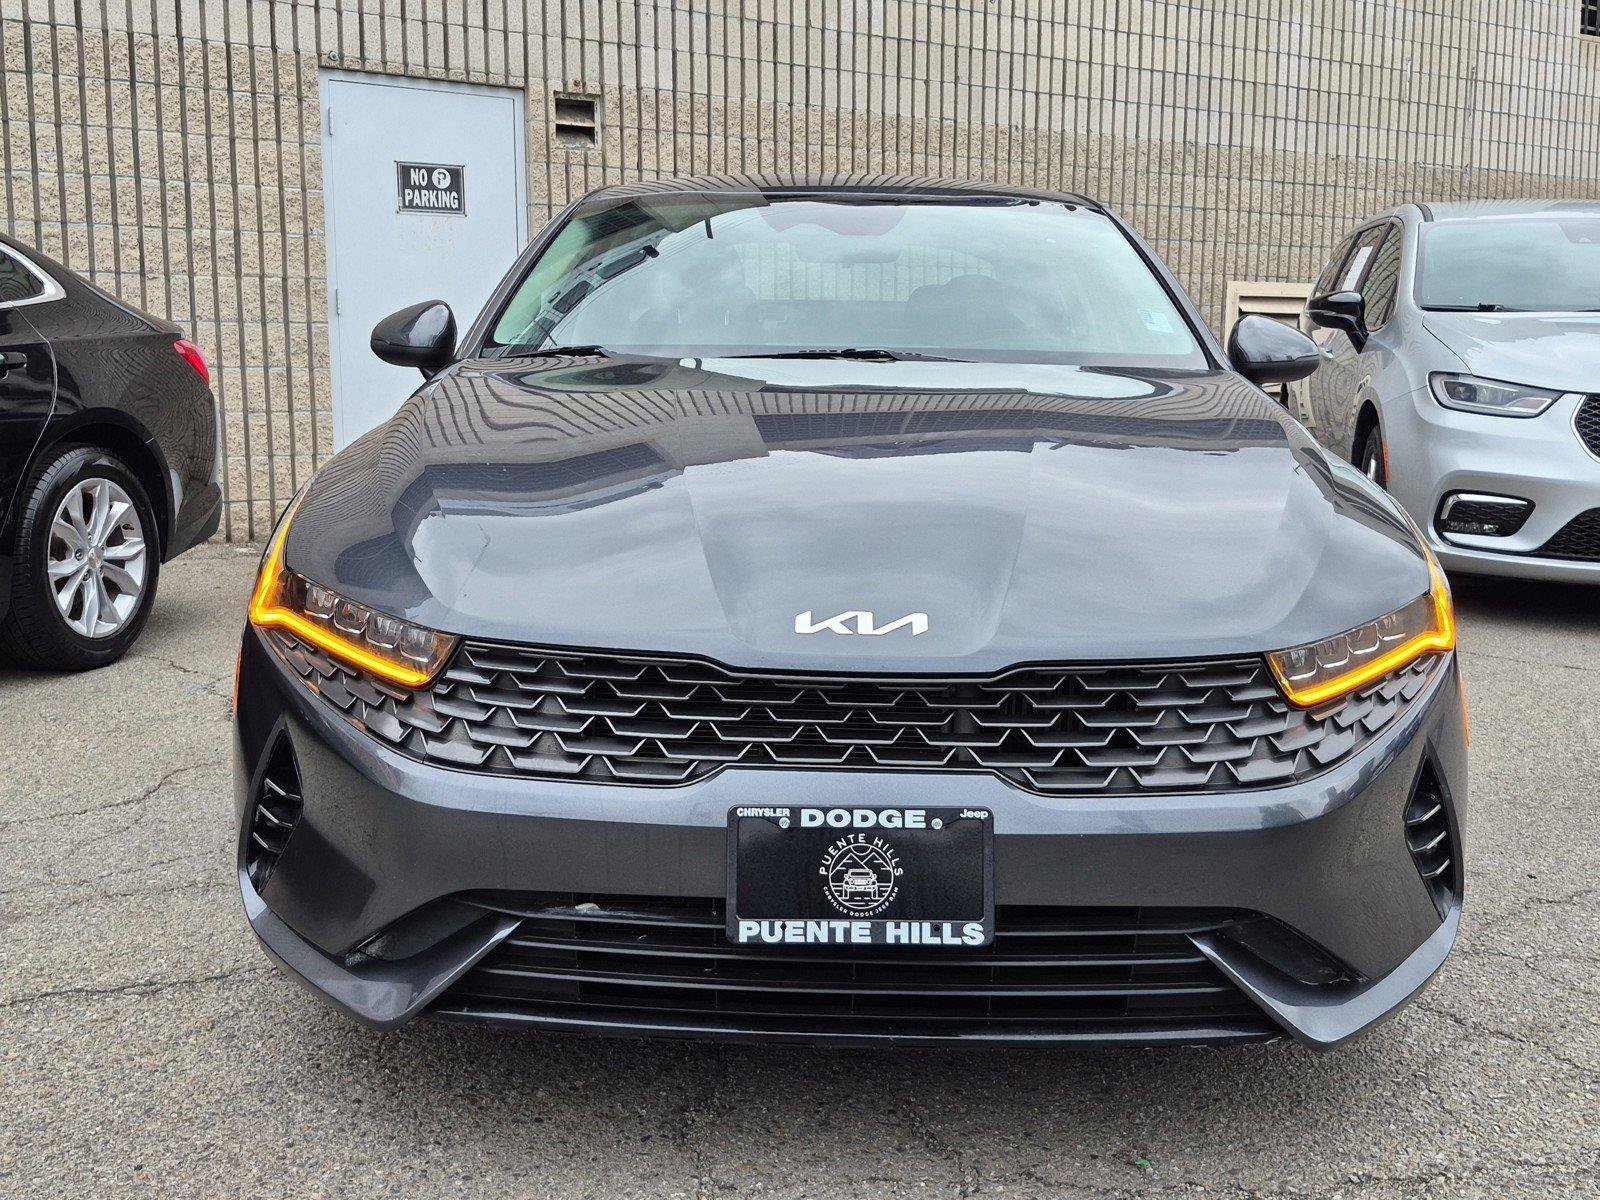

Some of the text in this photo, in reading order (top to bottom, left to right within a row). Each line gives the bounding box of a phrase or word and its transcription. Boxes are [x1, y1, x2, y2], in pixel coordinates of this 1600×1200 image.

[410, 168, 428, 187] NO
[404, 188, 459, 209] PARKING
[736, 808, 791, 817] CHRYSLER
[800, 808, 926, 829] DODGE
[960, 808, 989, 820] Jeep
[819, 833, 904, 876] PUENTE HILLS
[823, 886, 899, 918] CHRYSLER DODGE JEEP RAM
[738, 920, 985, 945] PUENTE HILLS
